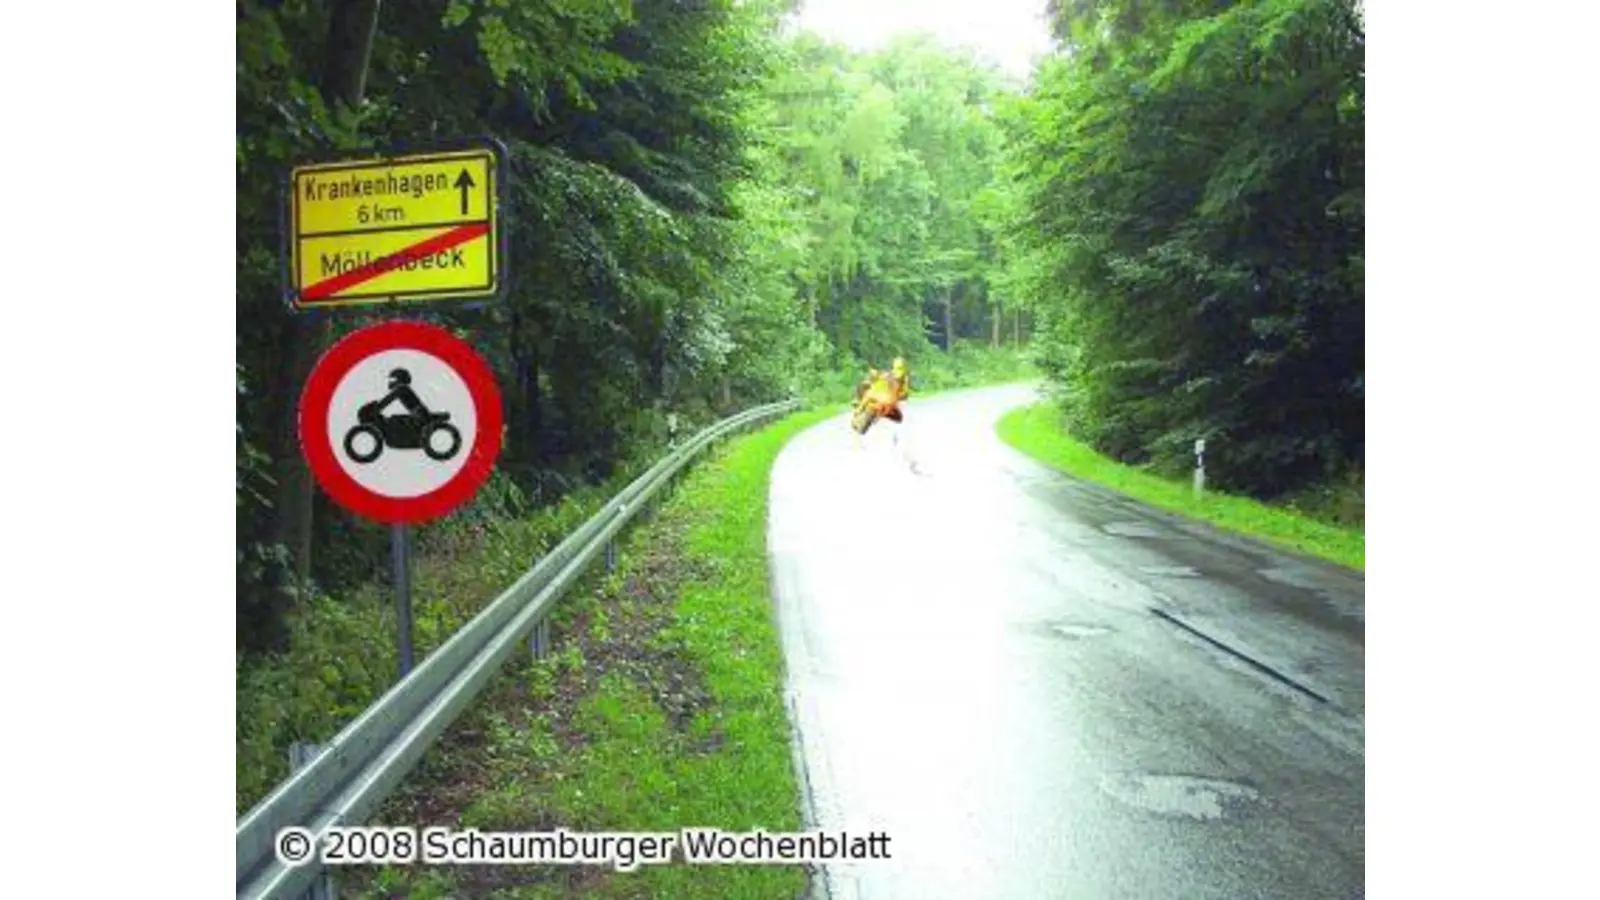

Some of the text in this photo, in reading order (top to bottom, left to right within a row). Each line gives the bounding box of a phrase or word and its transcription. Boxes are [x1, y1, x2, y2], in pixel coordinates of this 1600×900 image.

[304, 172, 449, 202] Krankenhagen
[356, 203, 405, 223] 6 km
